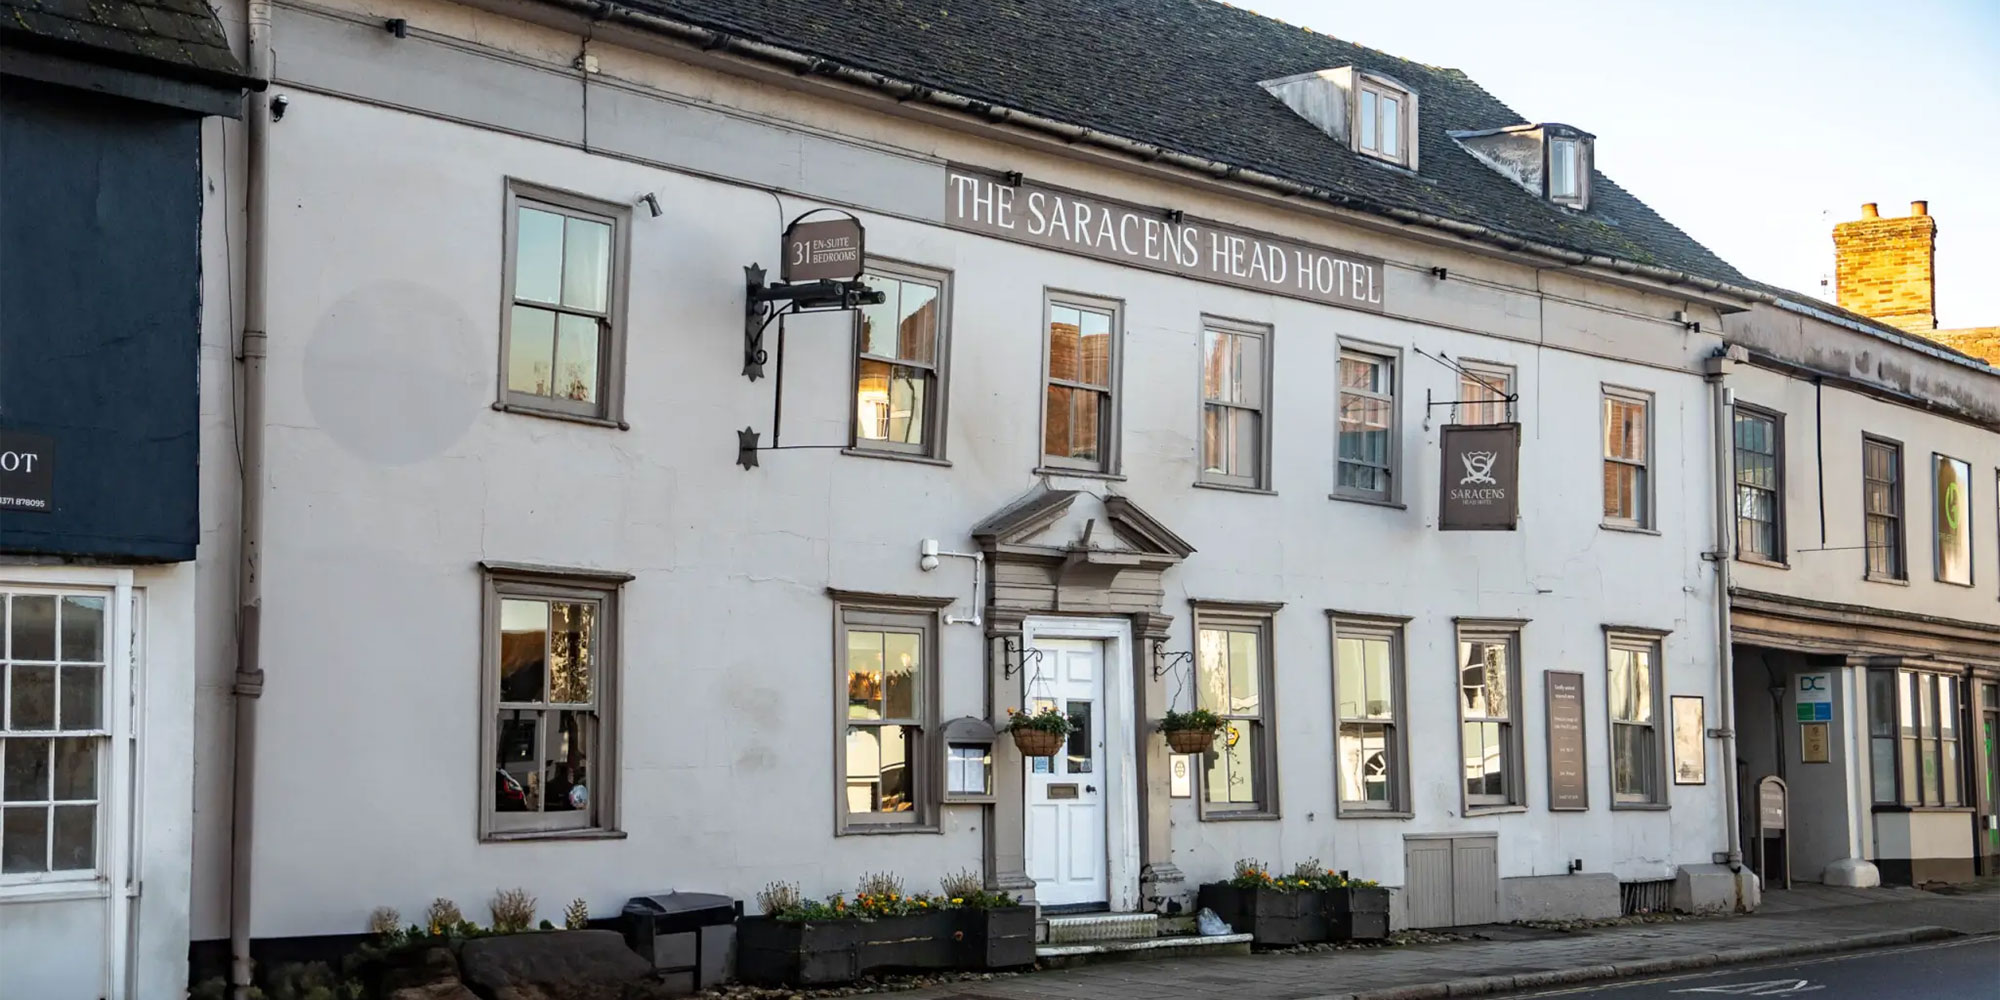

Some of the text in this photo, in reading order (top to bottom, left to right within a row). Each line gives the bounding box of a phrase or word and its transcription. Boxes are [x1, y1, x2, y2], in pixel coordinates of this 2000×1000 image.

[813, 237, 850, 250] EN-SUITE
[950, 173, 1381, 304] THE SARACENS HEAD HOTEL
[792, 241, 811, 266] 31
[813, 250, 857, 264] BEDROOMS
[1450, 488, 1505, 500] SARACENS
[15, 498, 46, 508] 878095
